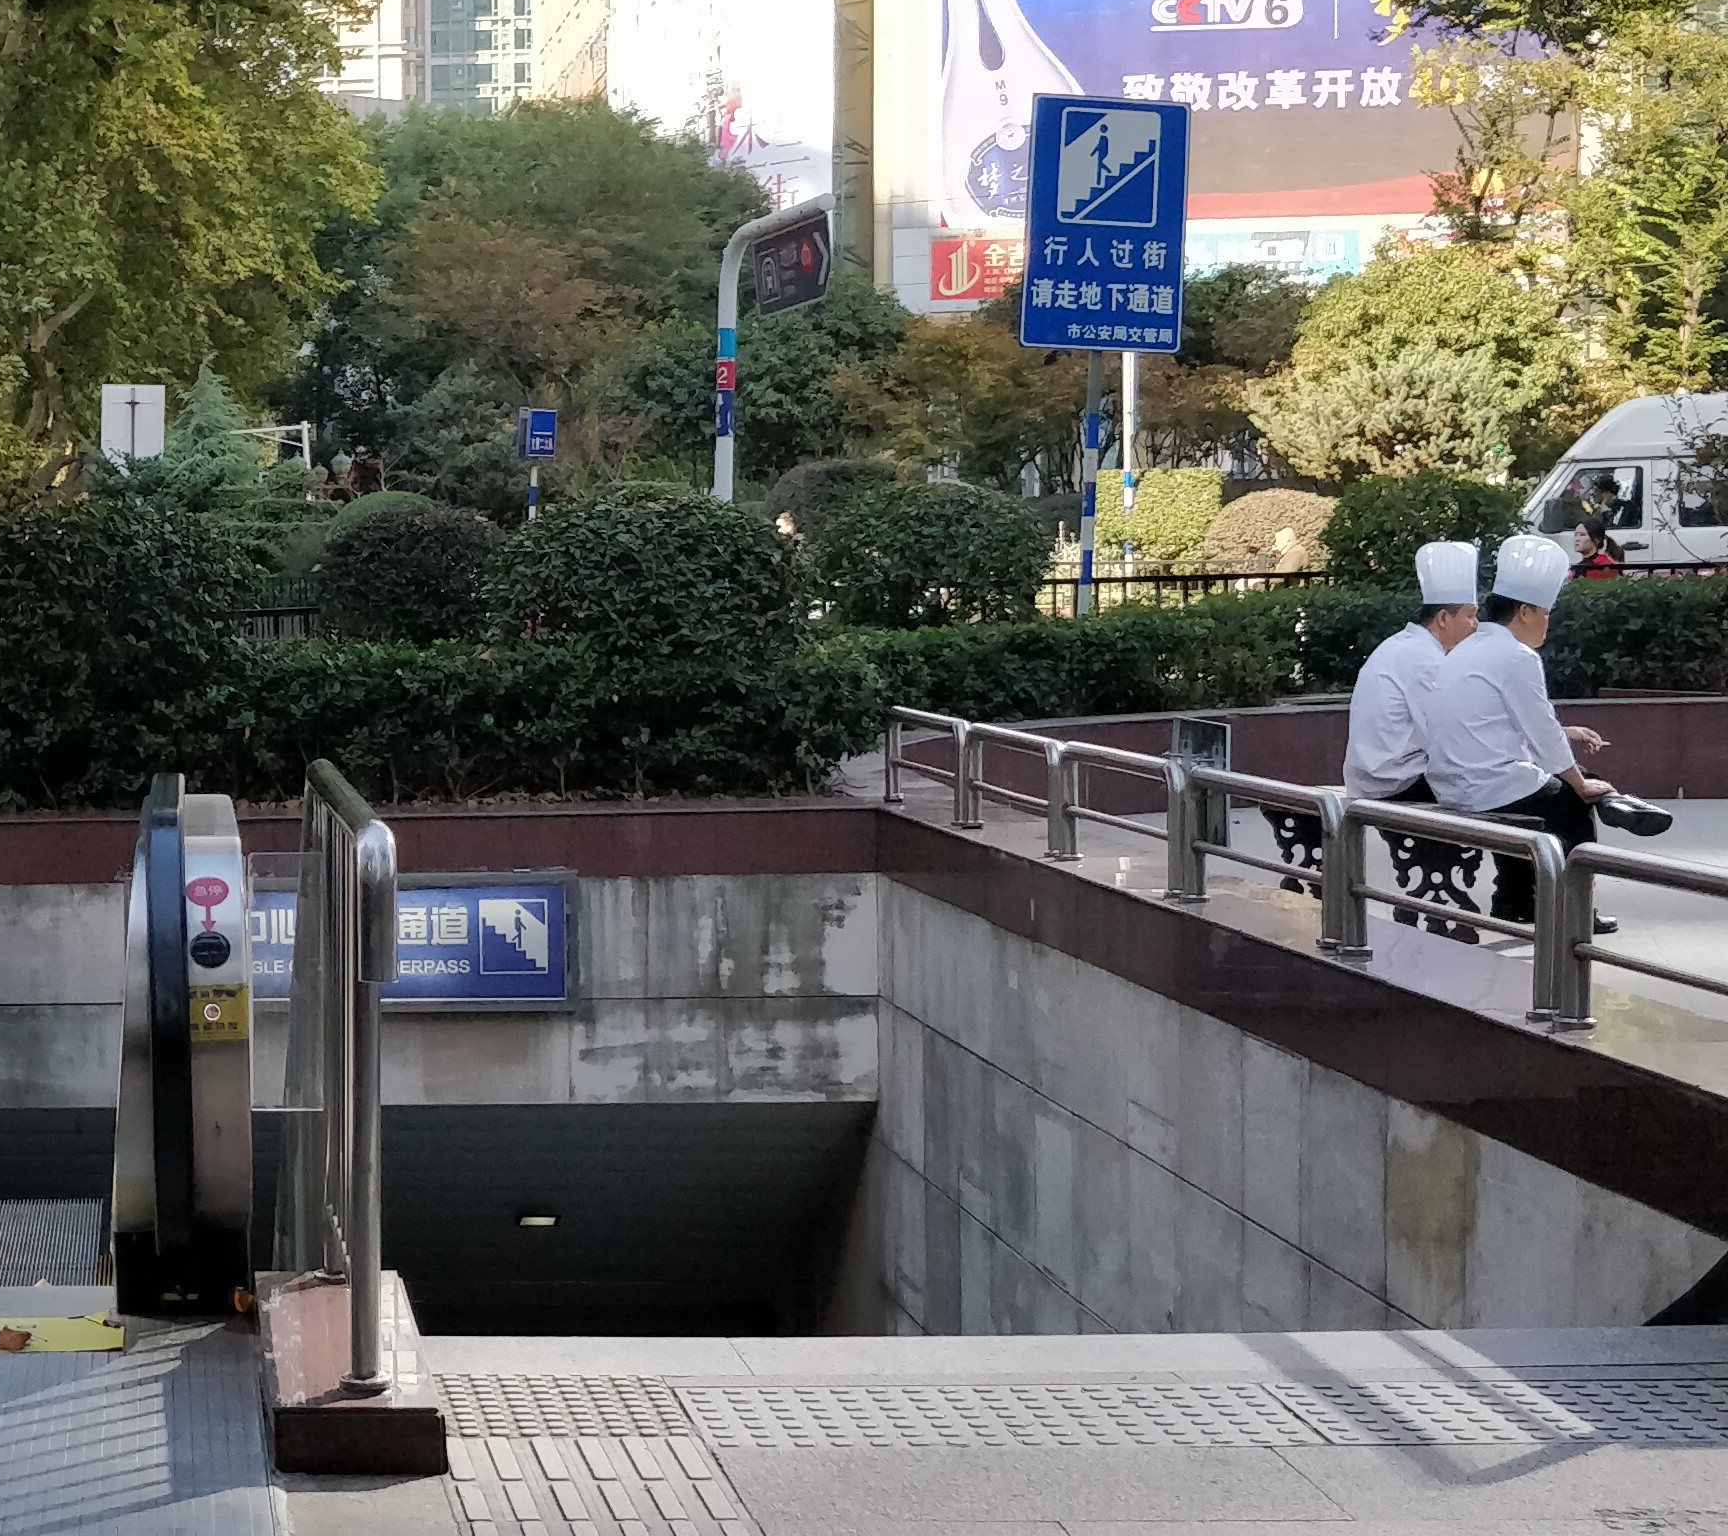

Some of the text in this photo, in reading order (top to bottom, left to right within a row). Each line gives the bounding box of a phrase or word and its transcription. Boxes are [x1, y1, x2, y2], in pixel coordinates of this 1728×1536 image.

[1043, 235, 1168, 270] 行人过街
[1030, 277, 1175, 315] 请走地下通道
[1067, 323, 1173, 345] 市公安局交管局
[717, 366, 728, 384] 2
[193, 884, 224, 897] 急停
[398, 959, 471, 975] ERPASS
